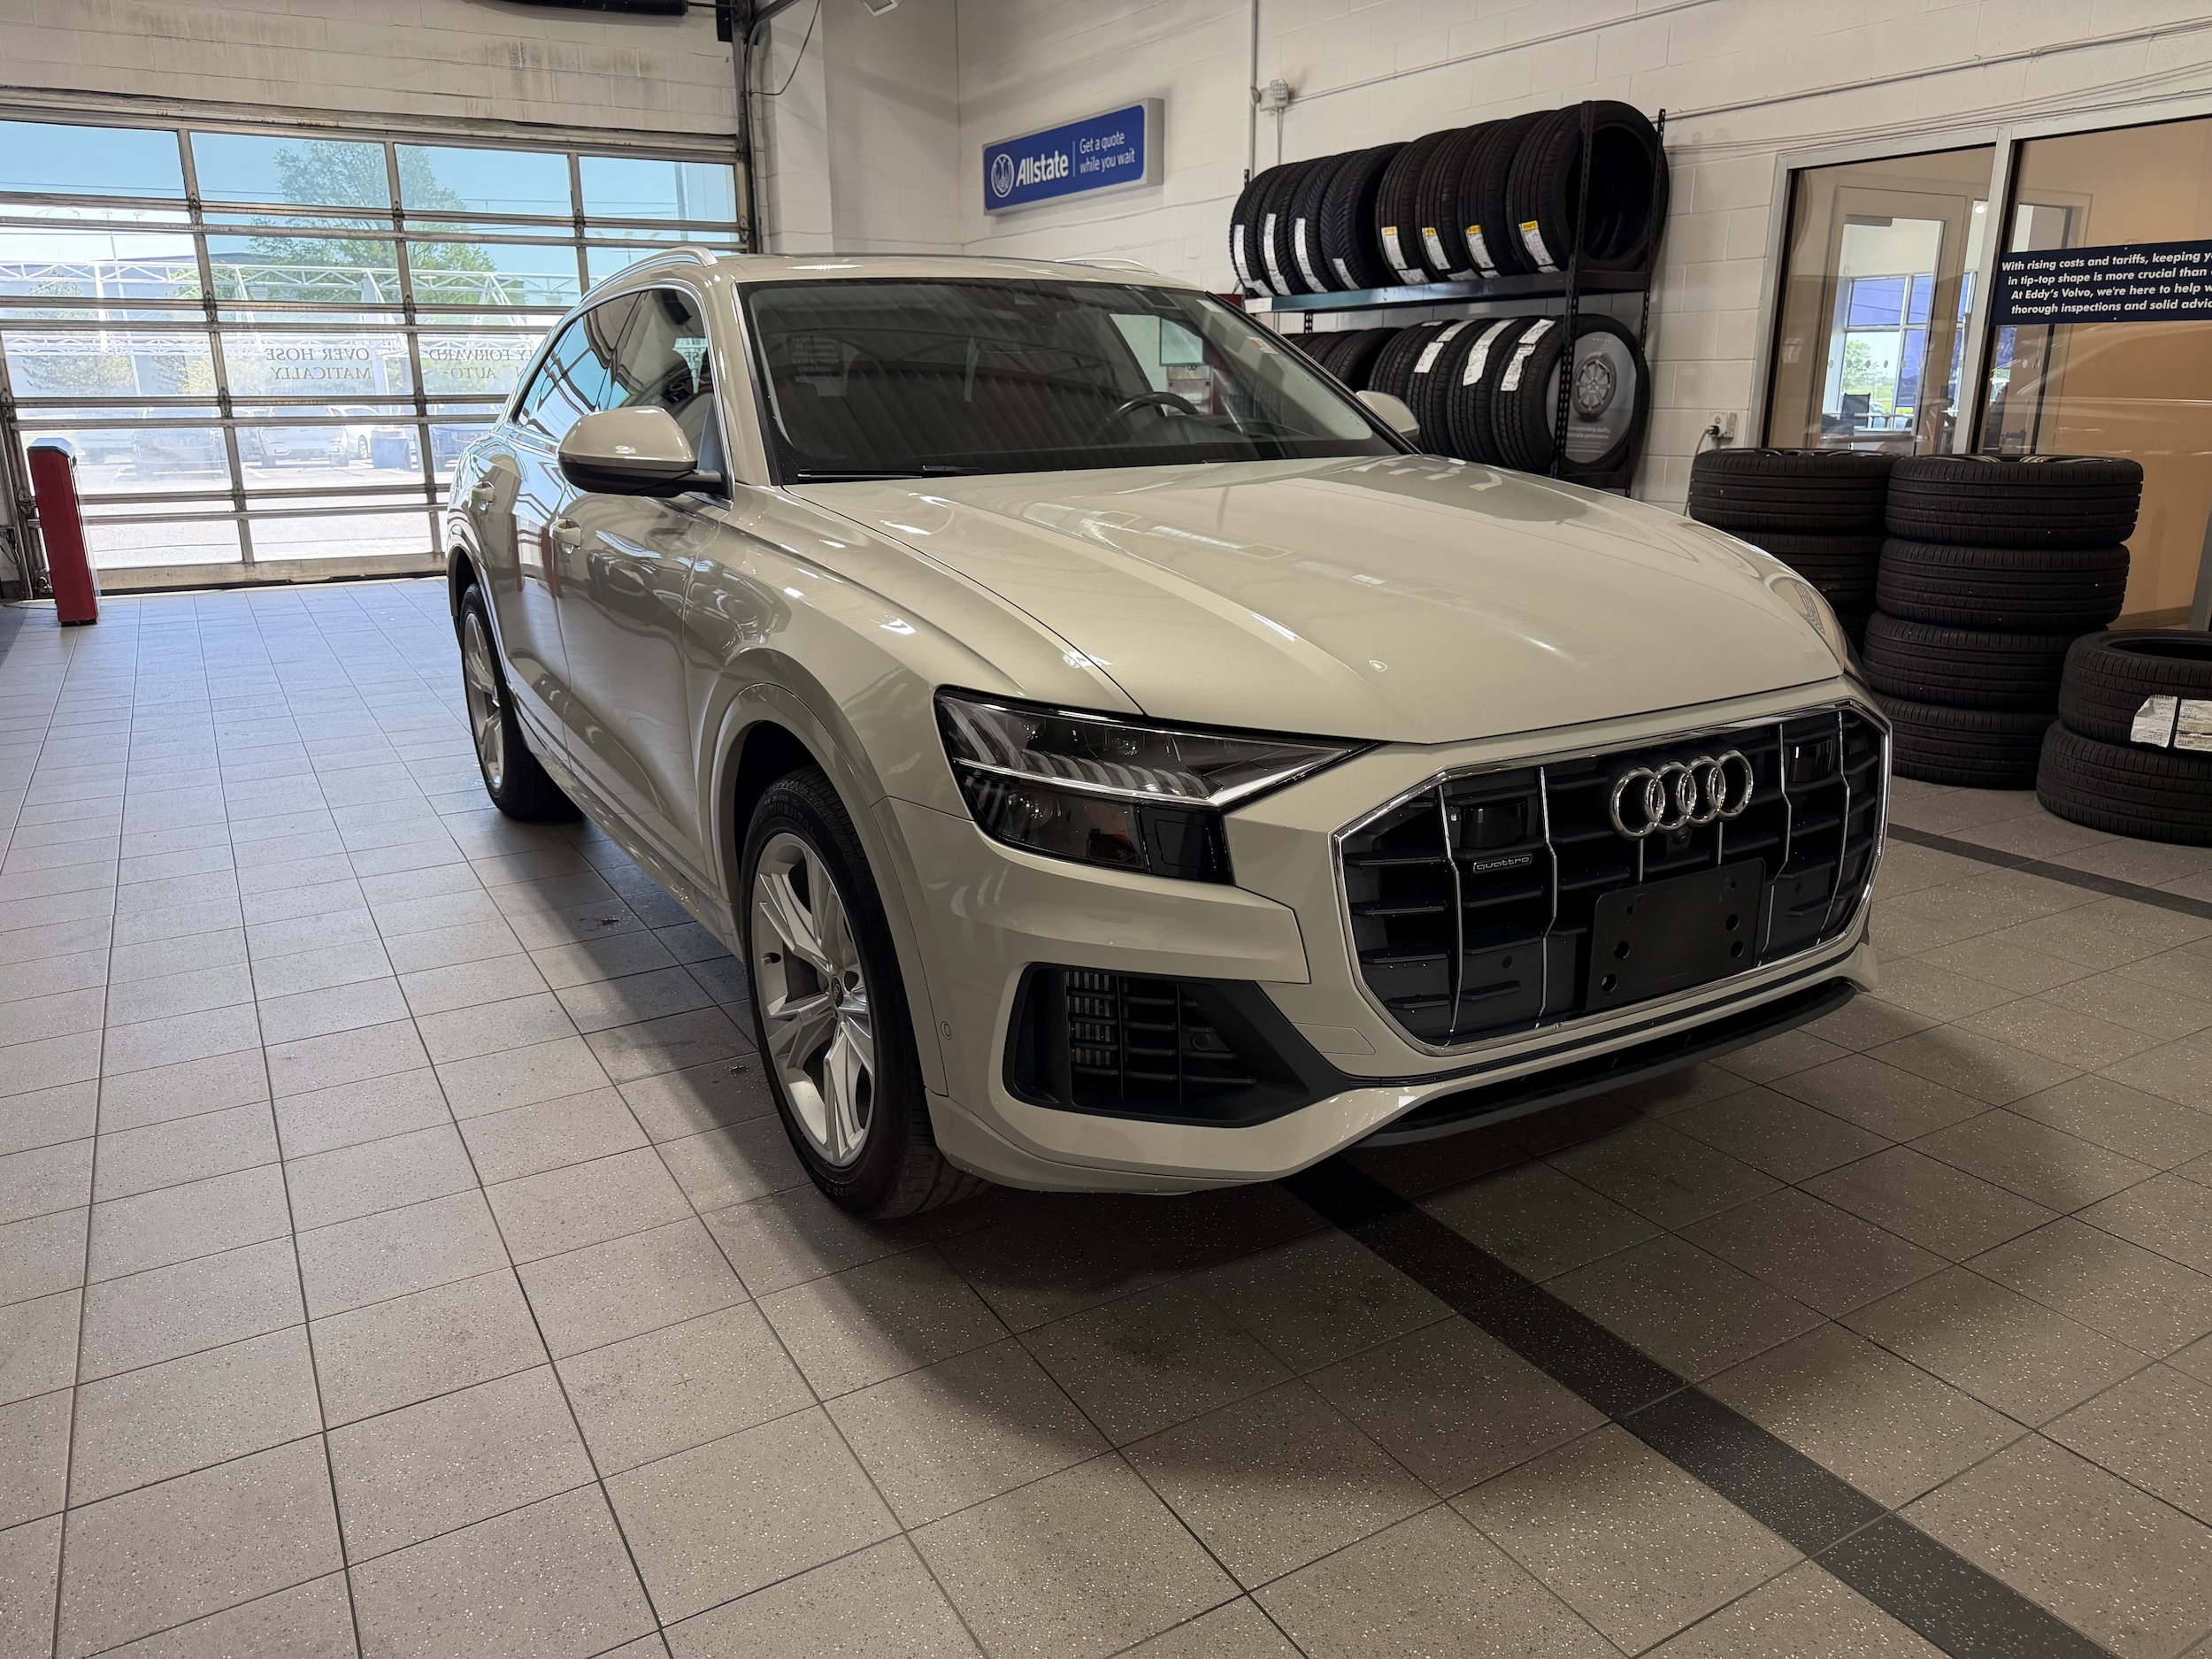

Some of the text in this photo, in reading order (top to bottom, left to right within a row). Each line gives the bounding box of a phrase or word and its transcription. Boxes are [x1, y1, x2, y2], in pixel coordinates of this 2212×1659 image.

[1079, 131, 1125, 154] Get a quote
[1016, 150, 1069, 187] Allstate
[1079, 148, 1135, 173] while you wait
[2001, 260, 2024, 271] With
[2026, 259, 2056, 271] rising
[2059, 258, 2085, 268] costs
[2087, 256, 2109, 266] and
[2112, 253, 2149, 265] tariffs,
[2152, 251, 2201, 264] keeping
[2008, 276, 2018, 285] in
[2020, 275, 2055, 287] tip-top
[2057, 273, 2090, 284] shape
[2093, 272, 2102, 281] is
[2105, 272, 2134, 280] more
[2138, 267, 2177, 280] crucial
[2179, 266, 2208, 277] than
[2010, 290, 2023, 300] At
[2025, 288, 2059, 301] Eddy's
[2061, 288, 2094, 298] Volvo,
[2097, 286, 2126, 296] we're
[2129, 285, 2156, 295] here
[2159, 285, 2170, 294] to
[2174, 282, 2201, 295] help
[2011, 303, 2058, 315] thorough
[2061, 302, 2122, 314] inspections
[2124, 300, 2147, 311] and
[2149, 299, 2178, 310] solid
[1476, 856, 1530, 871] quattro
